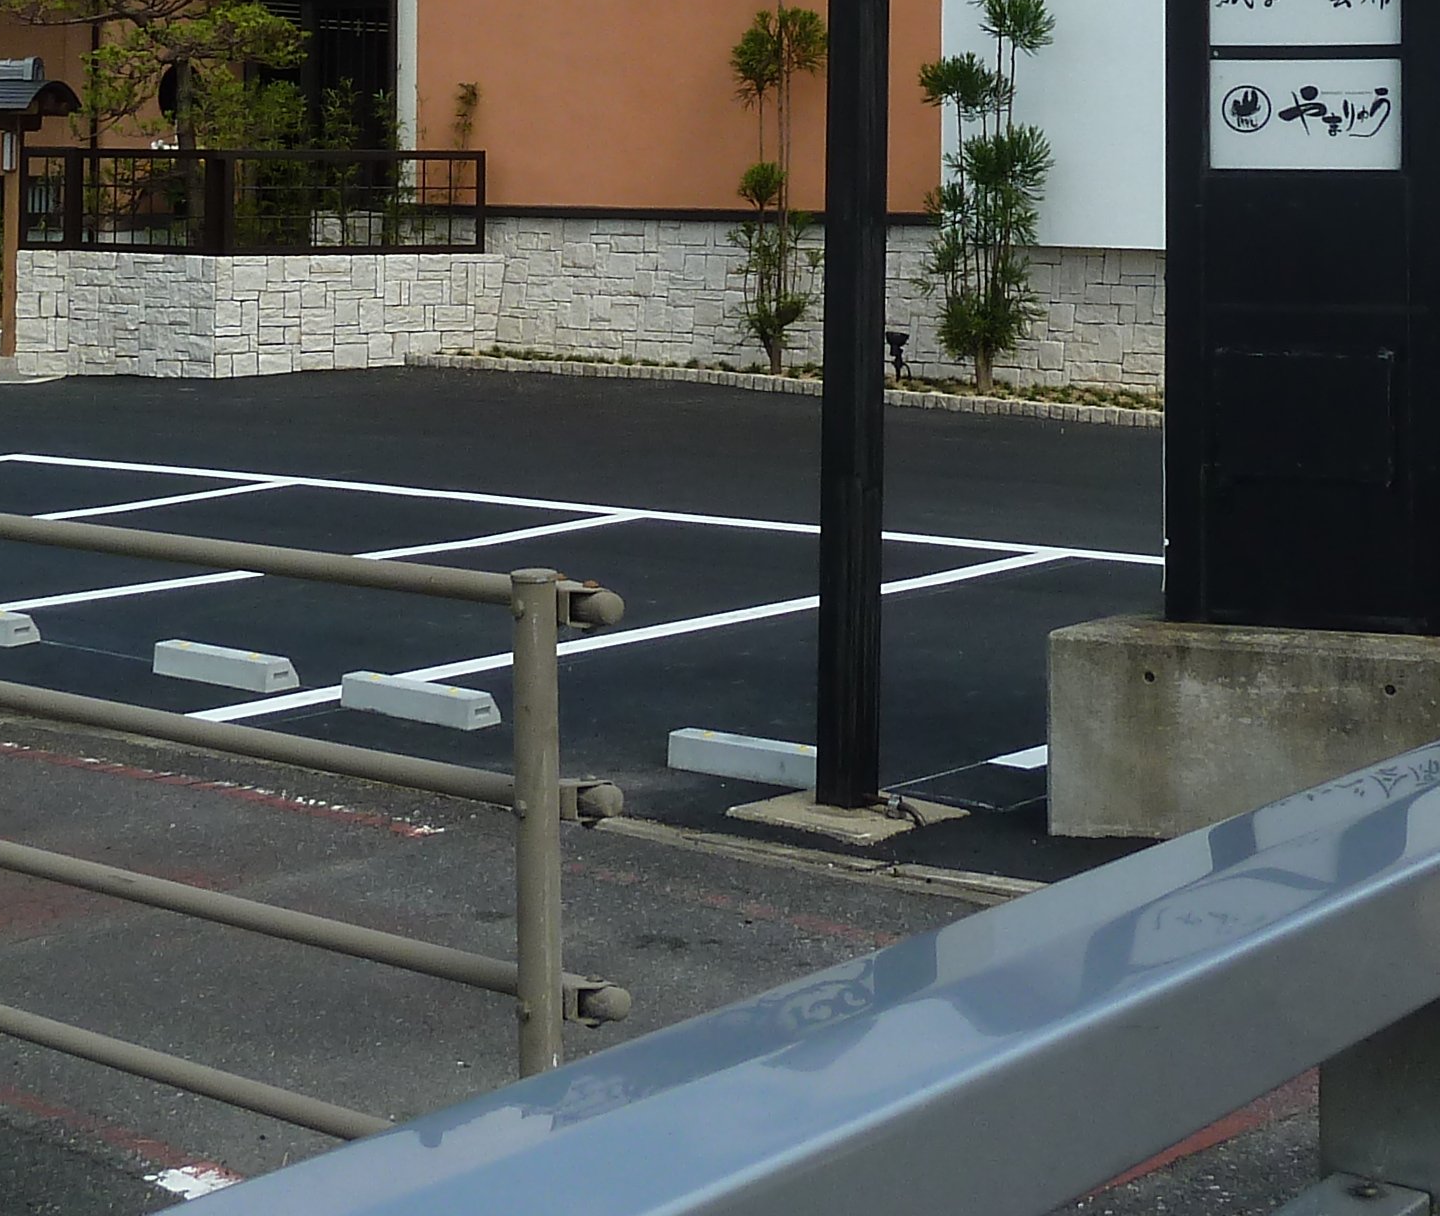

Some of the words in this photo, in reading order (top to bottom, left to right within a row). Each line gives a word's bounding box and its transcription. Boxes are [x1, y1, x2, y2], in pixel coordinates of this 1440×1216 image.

[1278, 85, 1391, 137] やまりゅう
